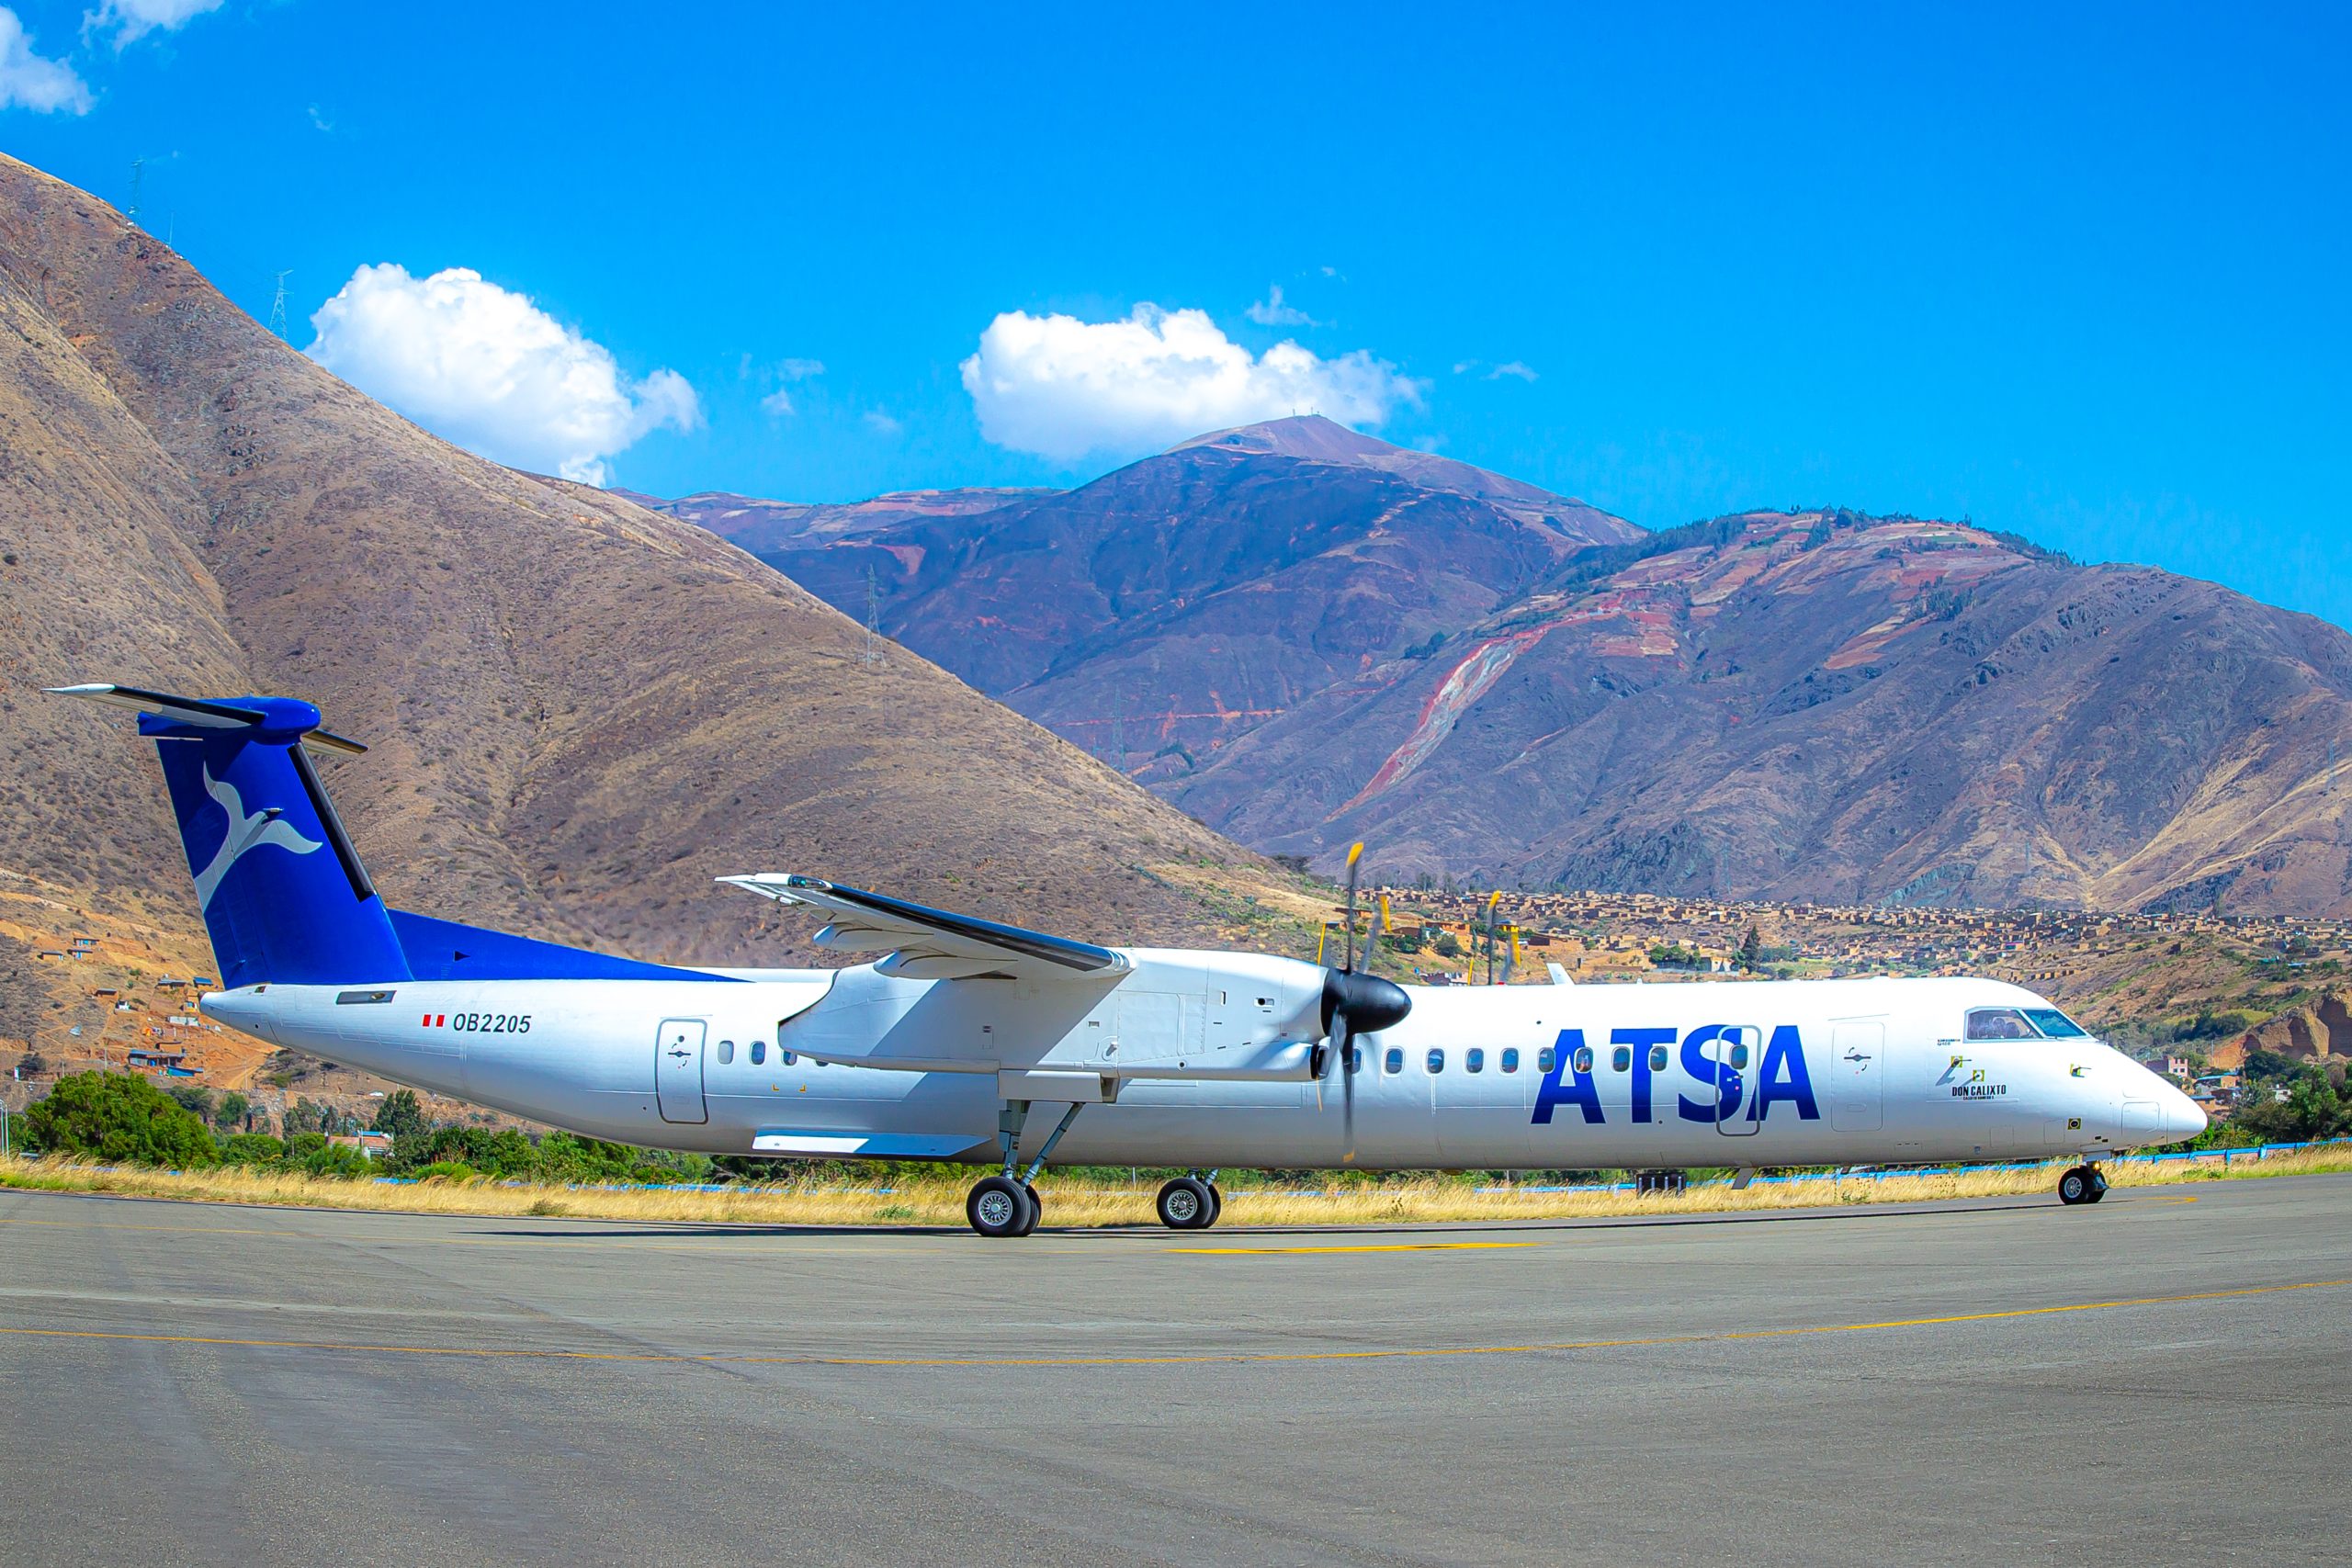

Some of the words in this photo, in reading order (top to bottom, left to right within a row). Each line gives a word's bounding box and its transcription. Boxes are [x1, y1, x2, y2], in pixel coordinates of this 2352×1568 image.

[453, 1013, 531, 1033] OB2205
[1530, 1024, 1821, 1124] ATSA
[1951, 1086, 1969, 1097] DON
[1971, 1084, 2007, 1096] CALIXTO
